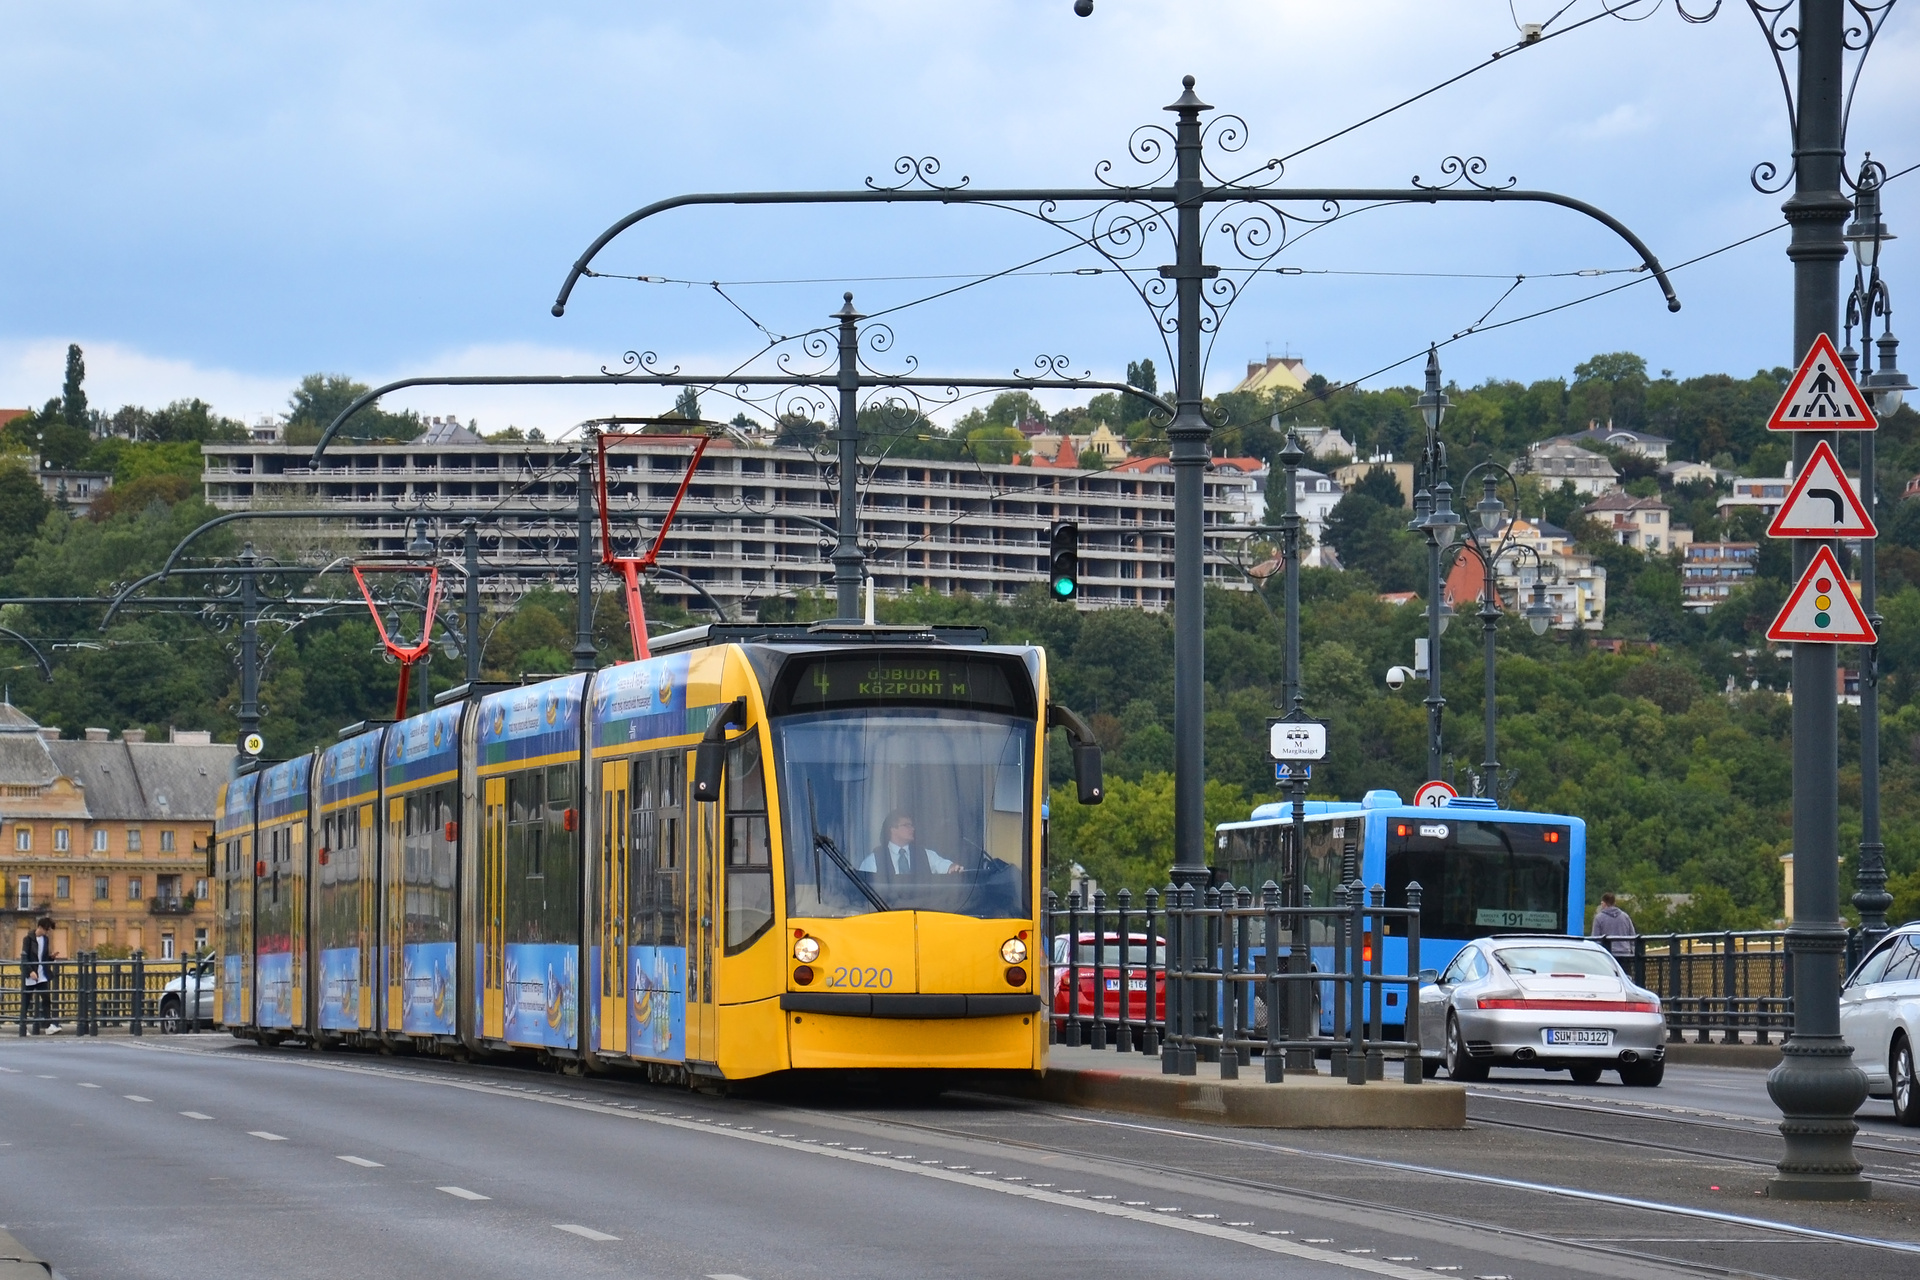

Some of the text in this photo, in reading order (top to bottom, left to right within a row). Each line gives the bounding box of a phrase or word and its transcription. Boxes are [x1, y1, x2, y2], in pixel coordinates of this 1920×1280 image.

[813, 667, 830, 695] 4
[858, 681, 965, 695] KÖZPONT M
[248, 739, 259, 748] 30
[1501, 912, 1524, 926] 191
[833, 966, 893, 989] 2020
[1554, 1031, 1572, 1041] SÜW
